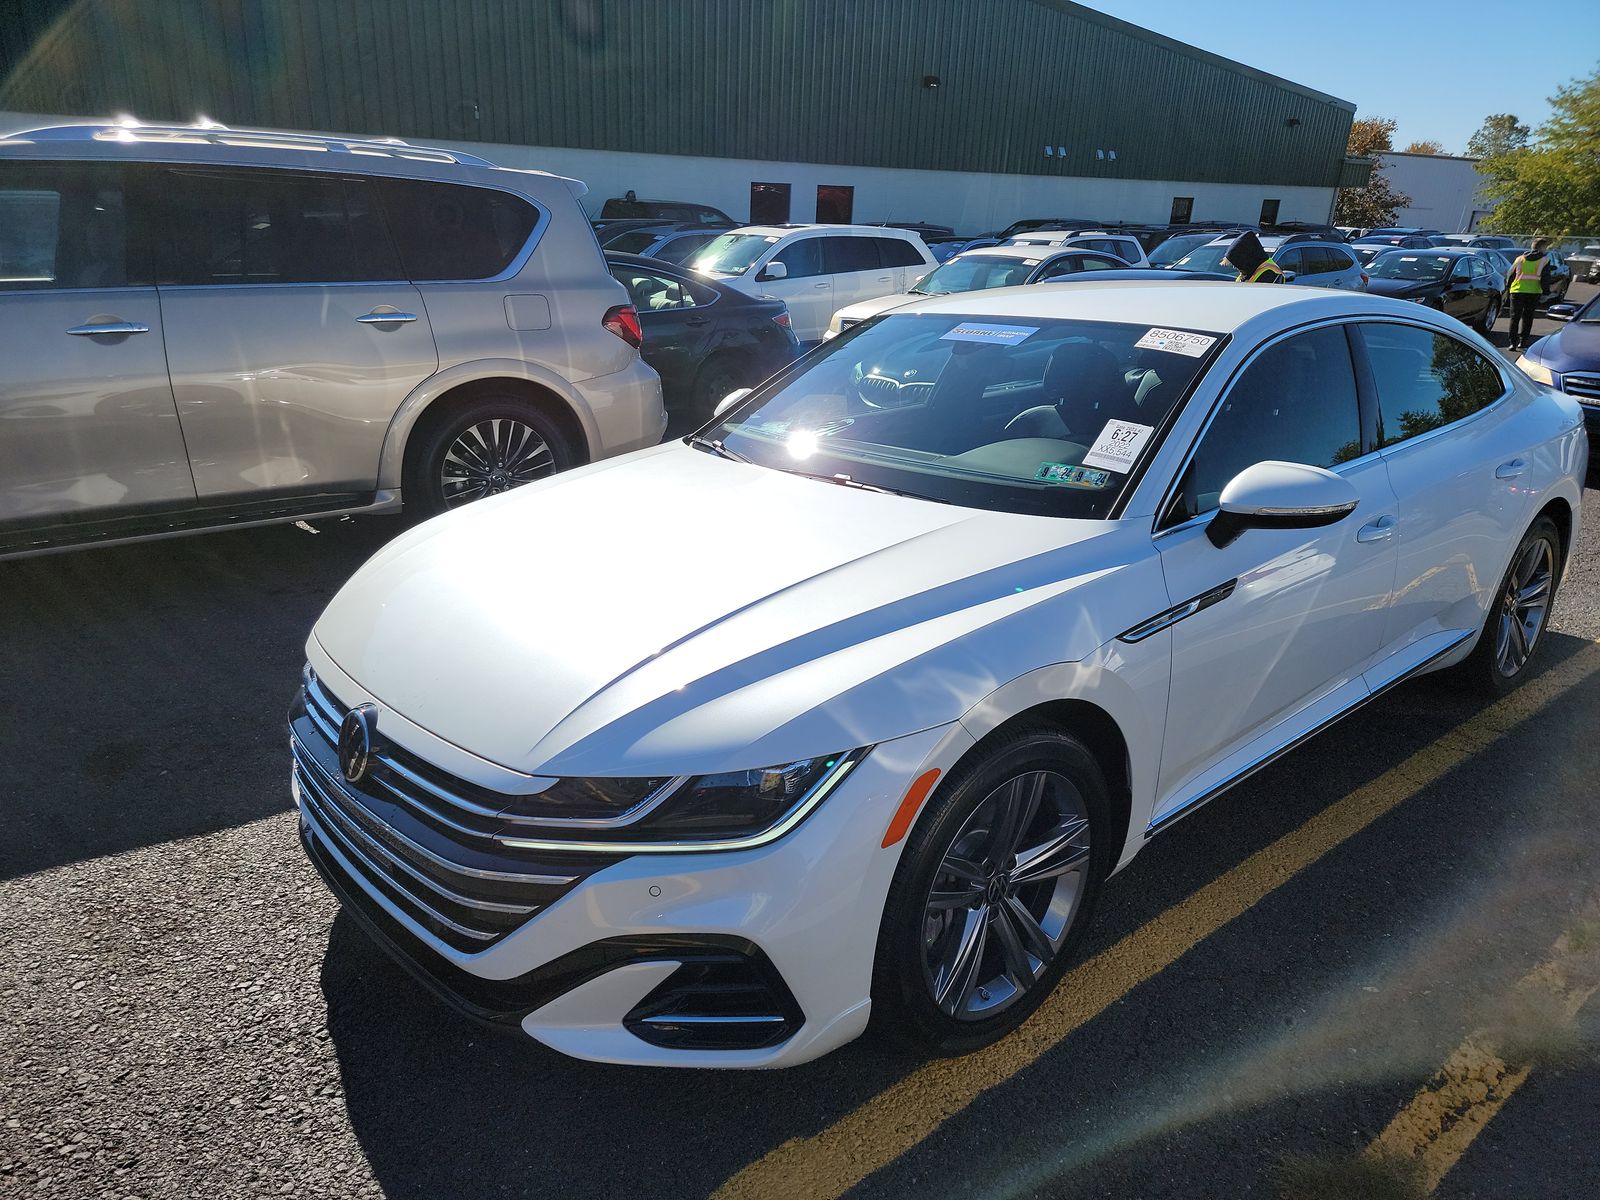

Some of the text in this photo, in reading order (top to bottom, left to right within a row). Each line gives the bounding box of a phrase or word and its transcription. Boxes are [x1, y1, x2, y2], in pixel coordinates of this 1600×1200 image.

[1149, 330, 1210, 346] 8506750
[1111, 429, 1138, 443] 6:27
[1109, 440, 1131, 450] 2022
[1042, 467, 1073, 479] 9 24
[1076, 471, 1107, 486] 9 24
